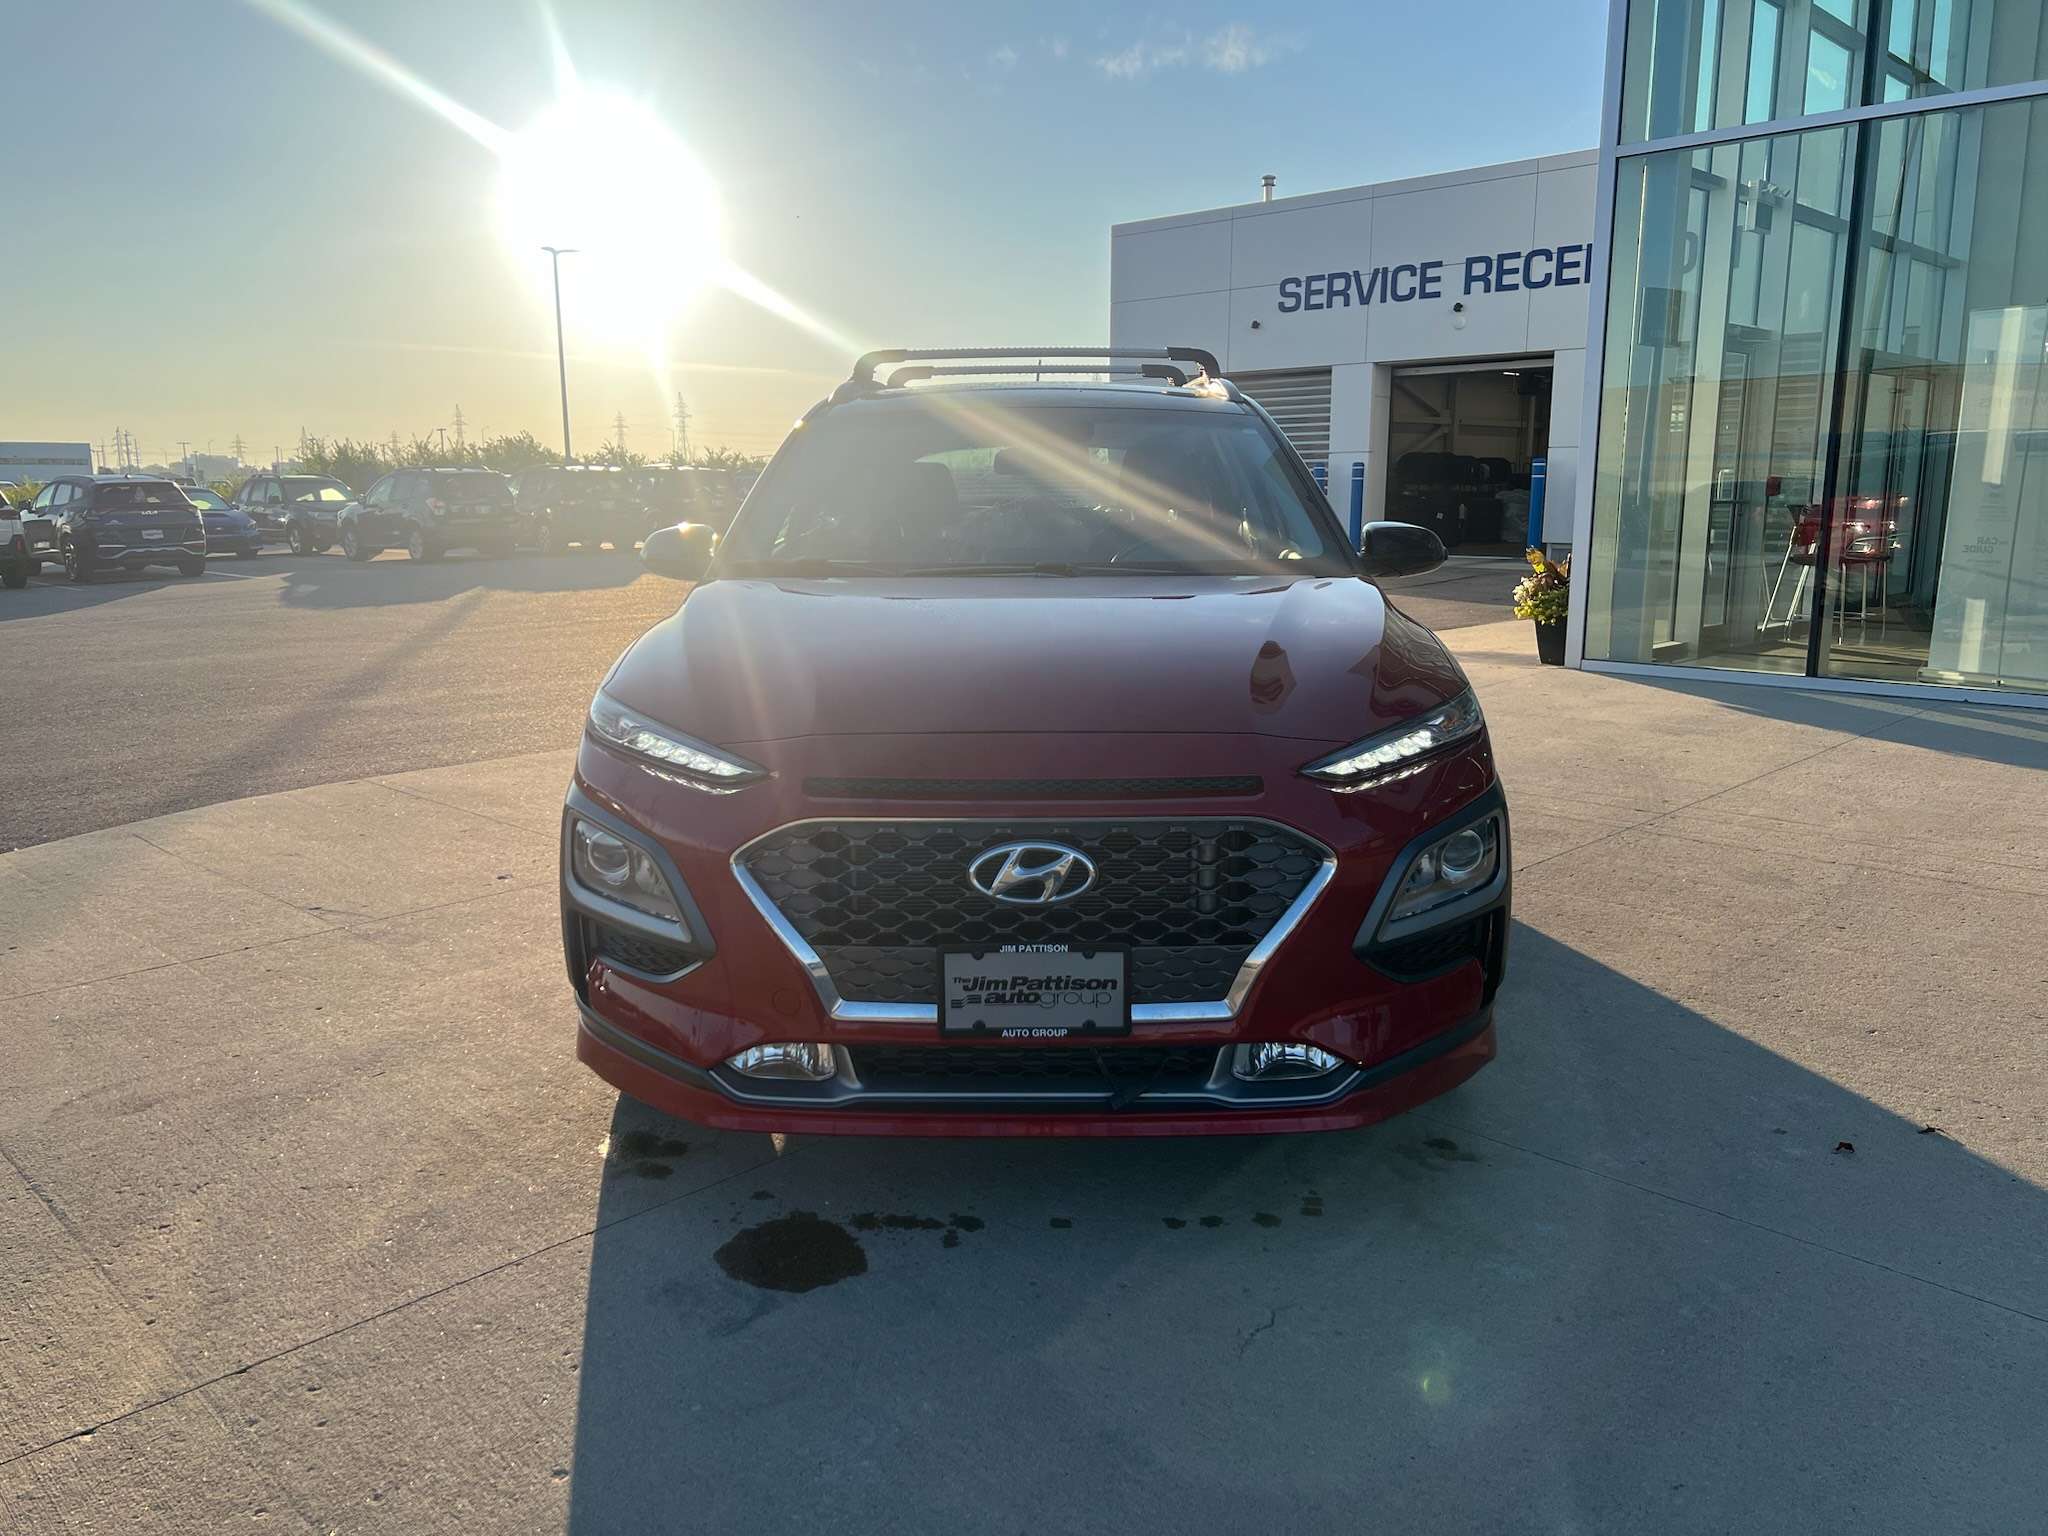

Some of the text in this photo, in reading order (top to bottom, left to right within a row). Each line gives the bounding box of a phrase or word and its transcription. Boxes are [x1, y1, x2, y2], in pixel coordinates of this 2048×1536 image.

[1278, 261, 1443, 313] SERVICE
[1010, 976, 1117, 990] Pattison
[1002, 1029, 1068, 1037] AUTO GROUP
